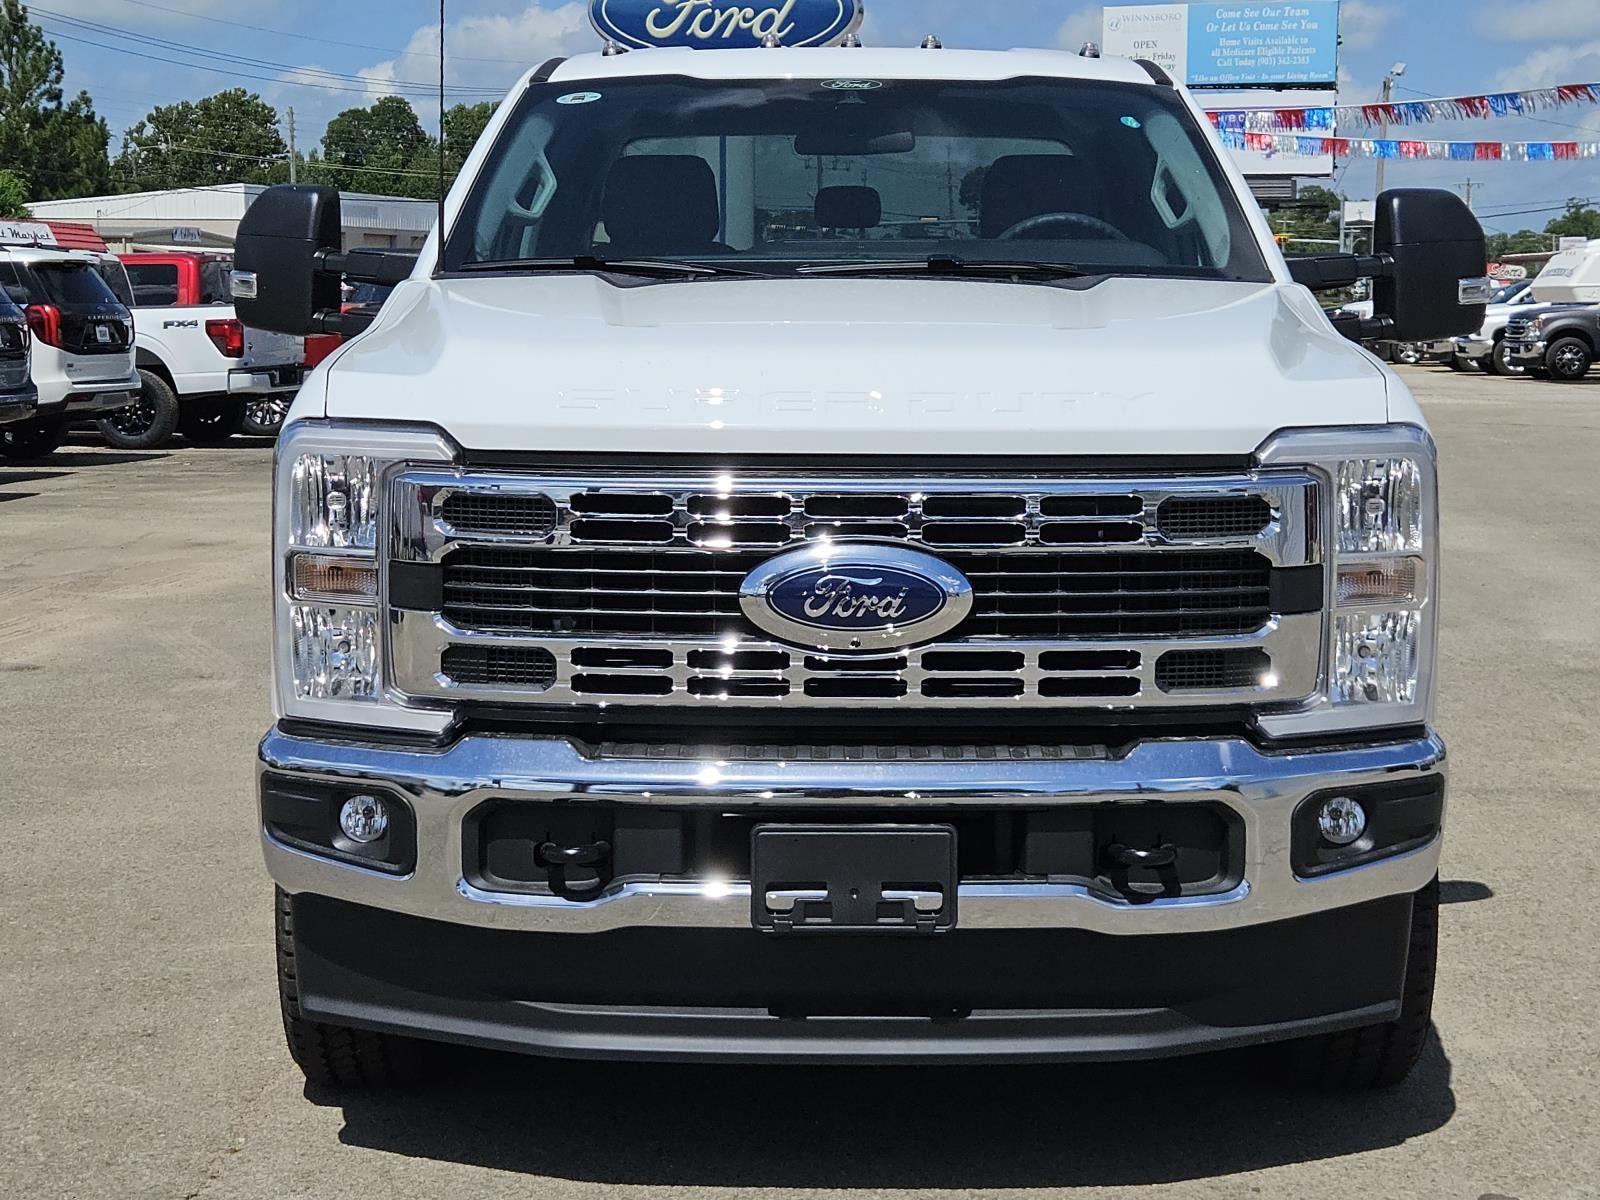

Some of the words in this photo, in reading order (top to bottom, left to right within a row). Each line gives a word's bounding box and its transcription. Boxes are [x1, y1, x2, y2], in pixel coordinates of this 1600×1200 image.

[1216, 9, 1240, 18] Come
[1244, 8, 1259, 18] See
[1262, 7, 1281, 17] Our
[1284, 6, 1310, 17] Team
[645, 0, 795, 39] Ford
[1206, 23, 1219, 33] Or
[1221, 22, 1236, 32] Let
[1239, 22, 1251, 31] Us
[1253, 21, 1278, 31] Come
[1281, 21, 1297, 30] See
[1300, 20, 1319, 30] You
[1133, 40, 1158, 49] OPEN
[1219, 38, 1241, 46] Home
[1242, 37, 1263, 46] Visits
[1265, 36, 1298, 45] Available
[1152, 51, 1176, 61] Friday
[1211, 48, 1221, 57] all
[1222, 47, 1256, 56] Medicare
[1257, 47, 1285, 57] Eligible
[1287, 46, 1316, 55] Patients
[1216, 58, 1233, 66] Call
[1235, 58, 1256, 67] Today
[831, 80, 870, 89] Ford
[8, 227, 52, 240] Market
[162, 319, 200, 330] FX4
[556, 387, 882, 411] SUPER
[906, 390, 1156, 414] DUTY
[803, 574, 909, 618] Ford
